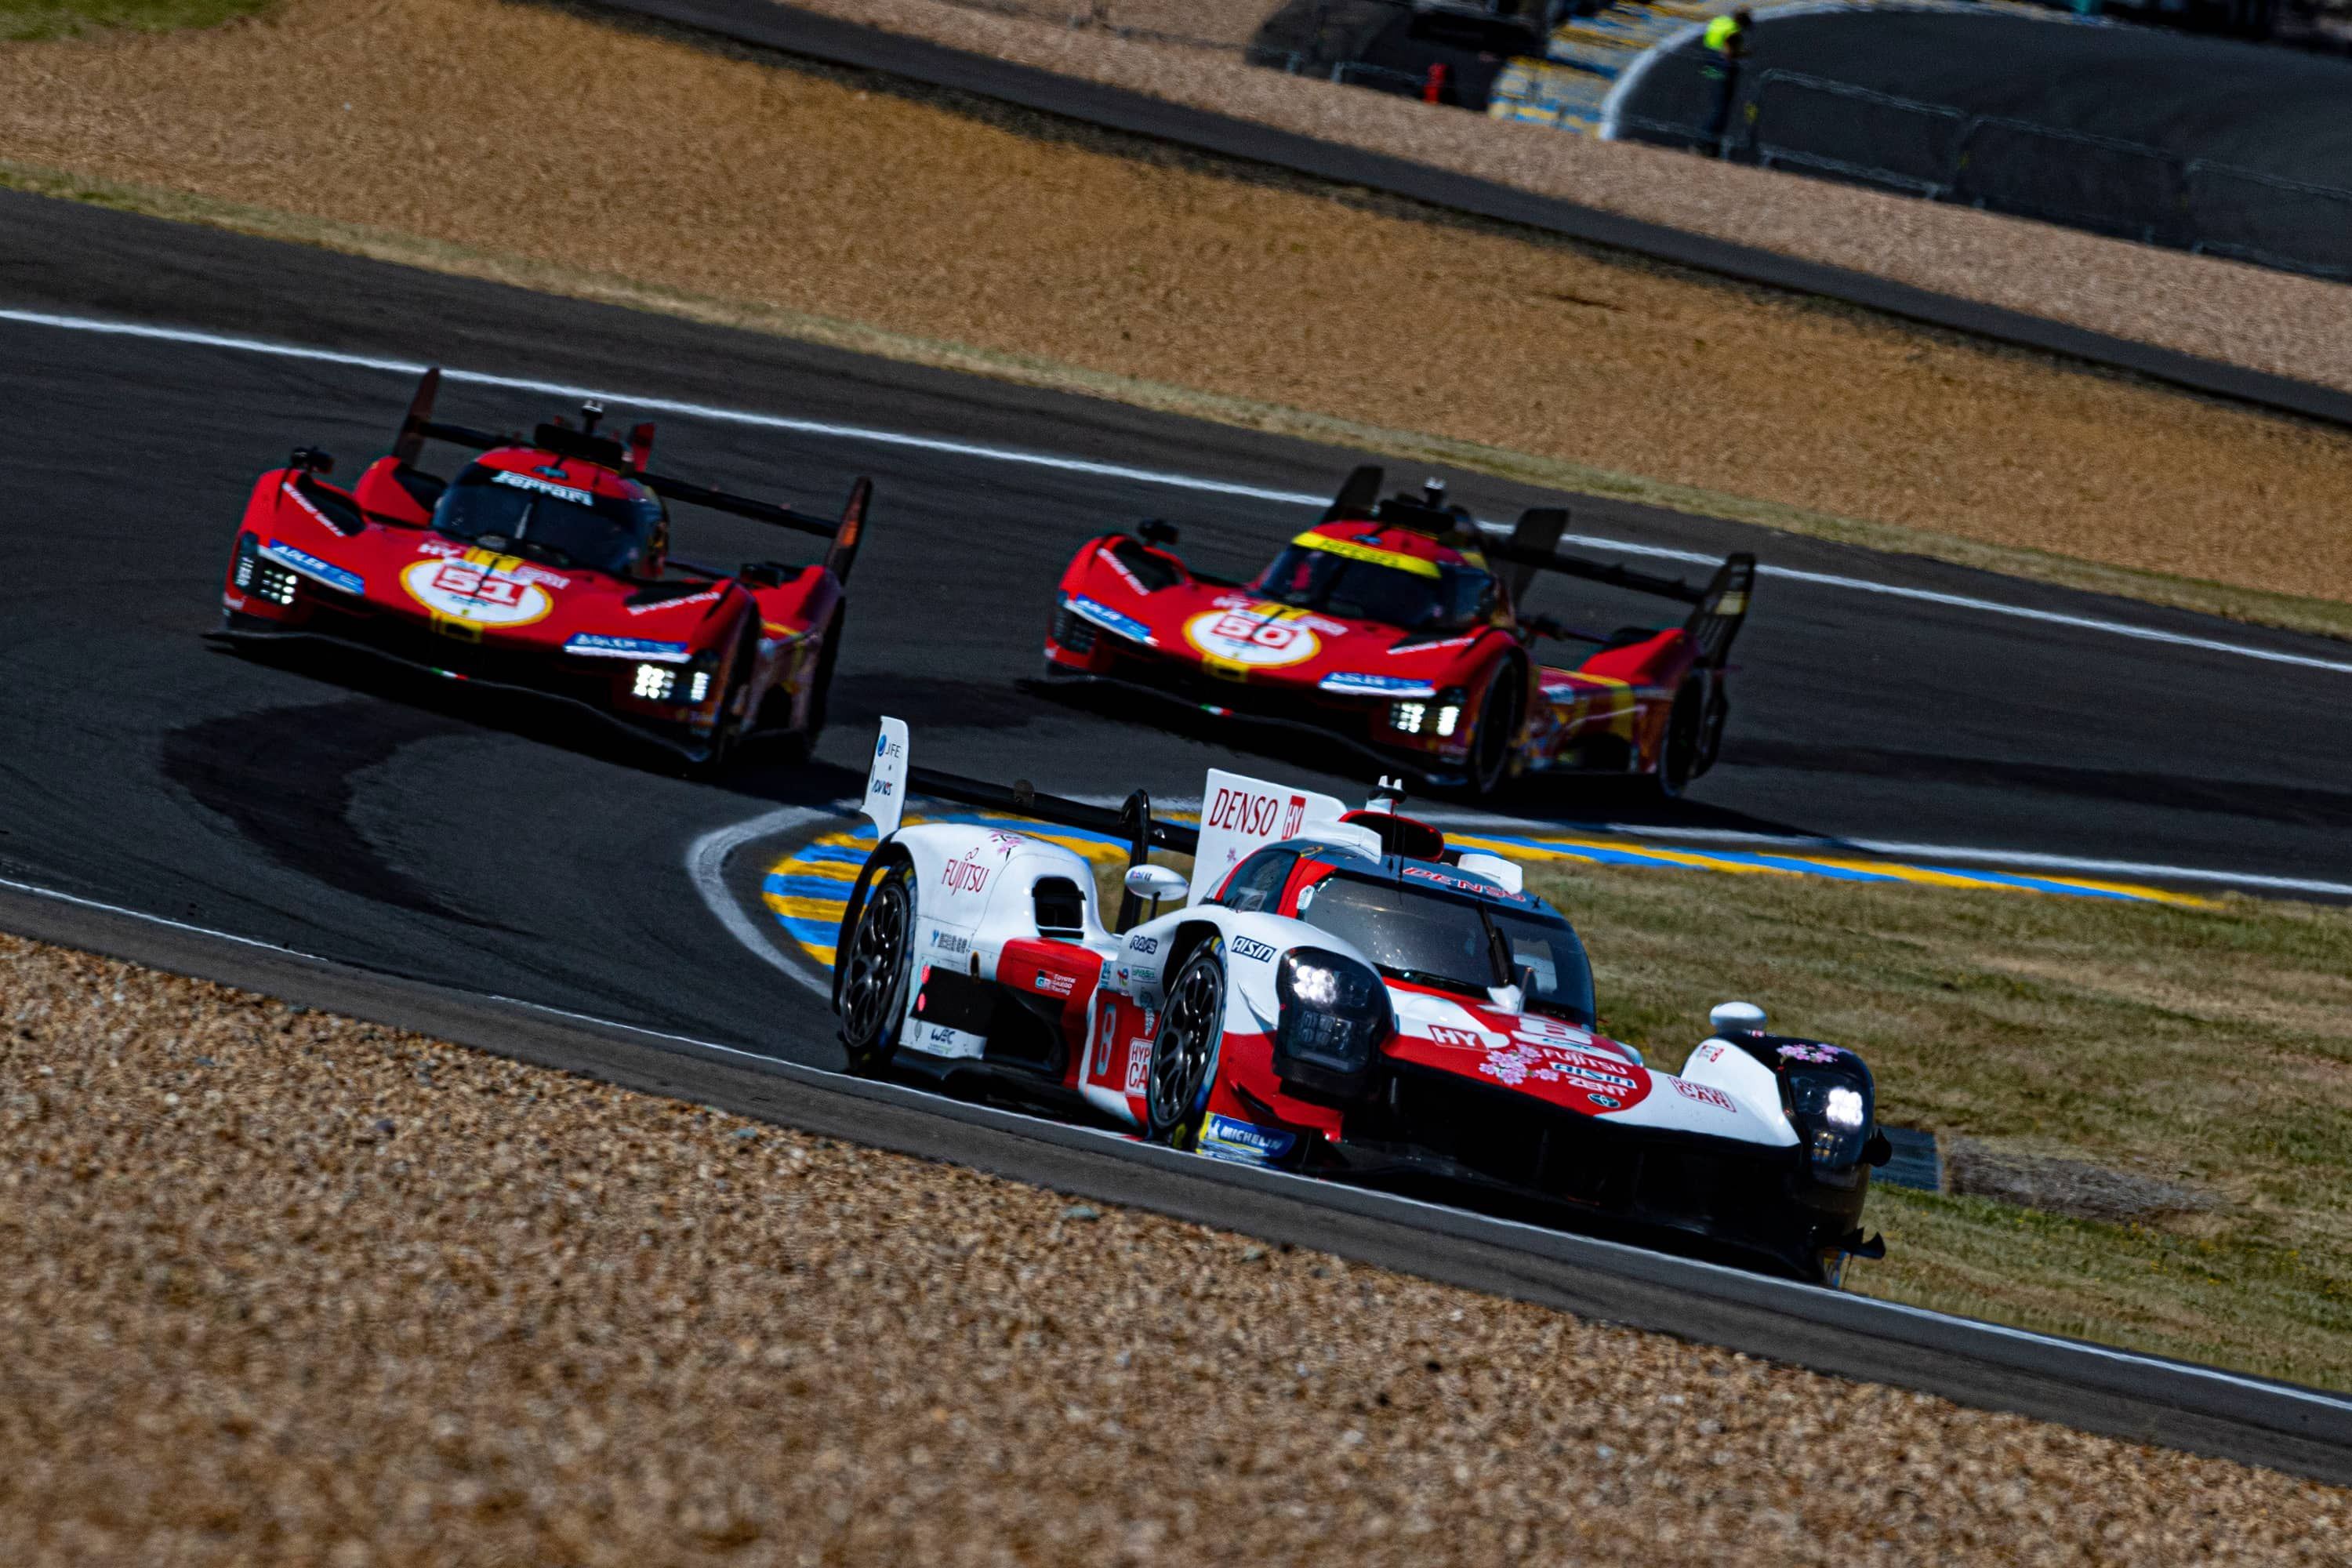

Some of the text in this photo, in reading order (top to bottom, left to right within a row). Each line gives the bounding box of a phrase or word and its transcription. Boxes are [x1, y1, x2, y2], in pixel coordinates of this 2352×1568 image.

[436, 567, 517, 604] 51
[1215, 615, 1294, 649] 50
[885, 742, 902, 759] JFE
[1208, 787, 1279, 837] DENSO
[941, 858, 990, 896] FUJITSU
[1403, 866, 1526, 902] DENSO
[1231, 935, 1277, 963] AISIN
[1432, 1026, 1478, 1048] HY
[1542, 1047, 1628, 1075] FUJITSU
[1553, 1063, 1635, 1089] AISIN
[1567, 1075, 1629, 1097] ZENT
[1220, 1124, 1283, 1150] MICHELIN
